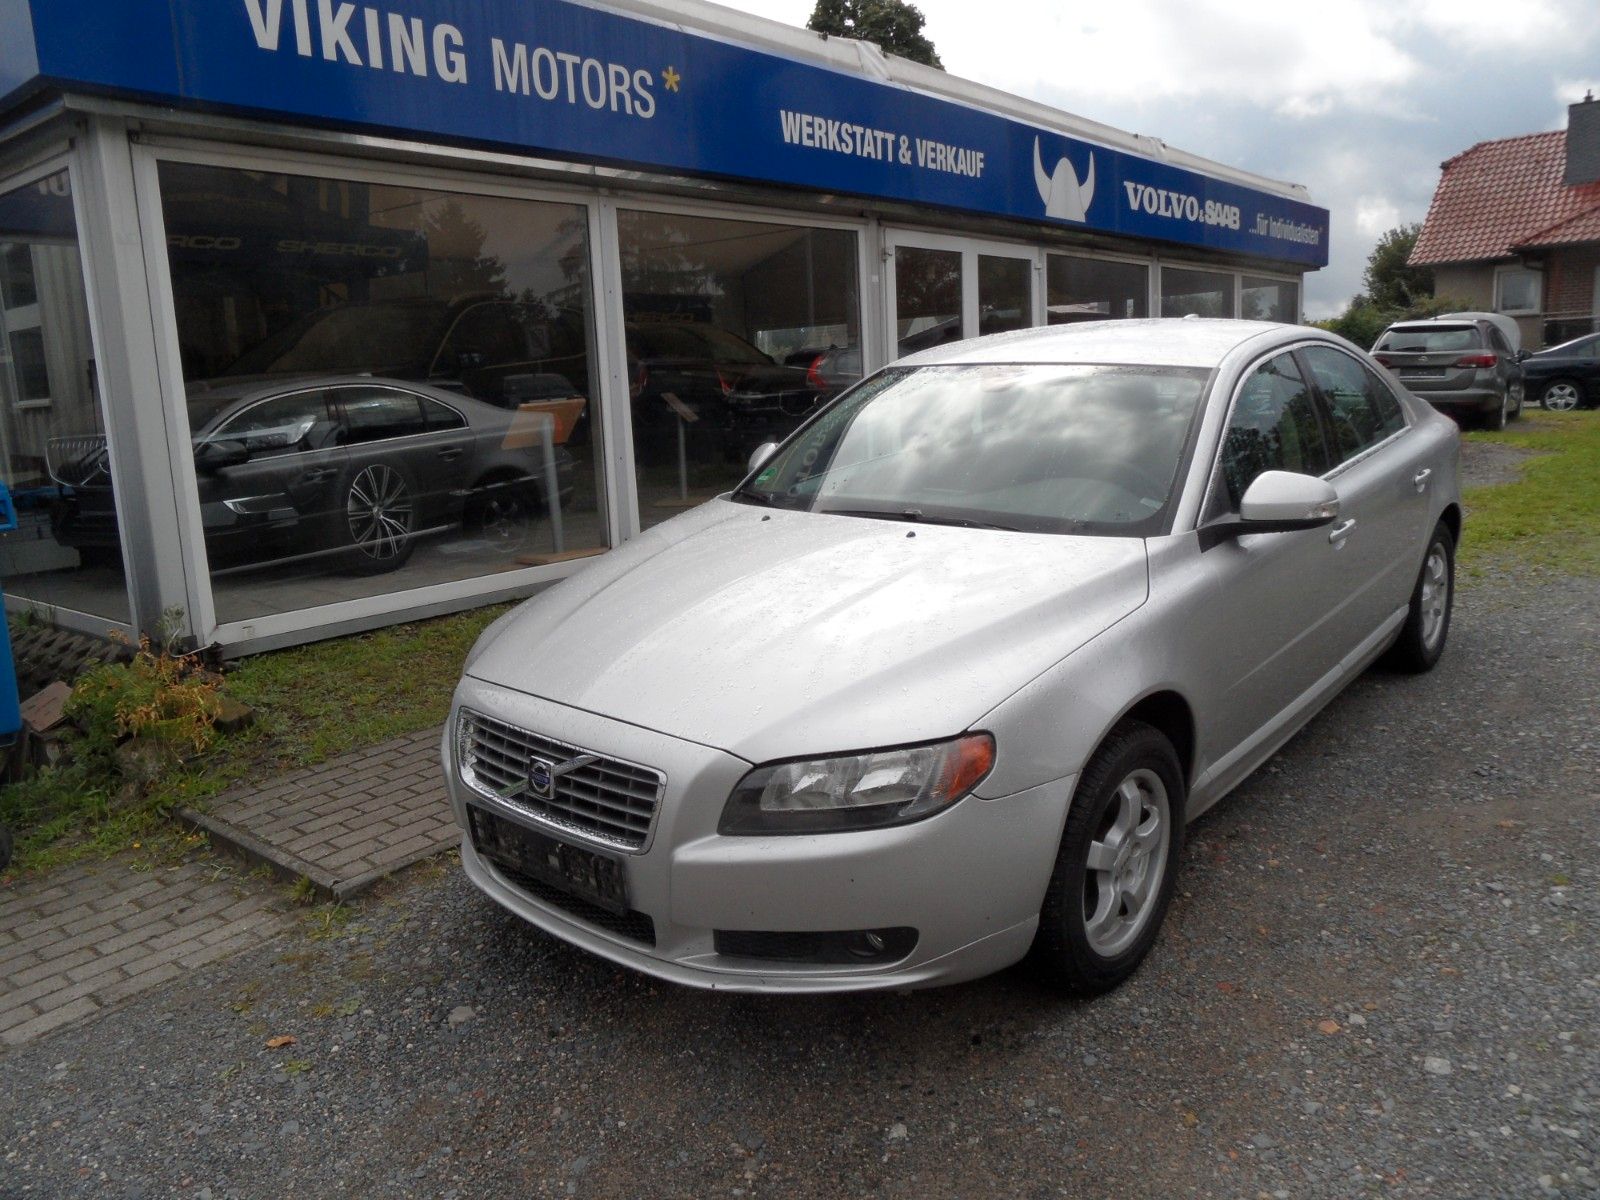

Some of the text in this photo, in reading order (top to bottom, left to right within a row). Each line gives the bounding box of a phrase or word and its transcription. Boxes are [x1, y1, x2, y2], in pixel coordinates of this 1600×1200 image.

[244, 0, 656, 119] VIKING MOTORS
[780, 110, 985, 178] WERKSTATT & VERKAUF
[1124, 181, 1199, 222] VOLVO
[1205, 200, 1240, 230] SAAB
[277, 239, 402, 258] SHERCO
